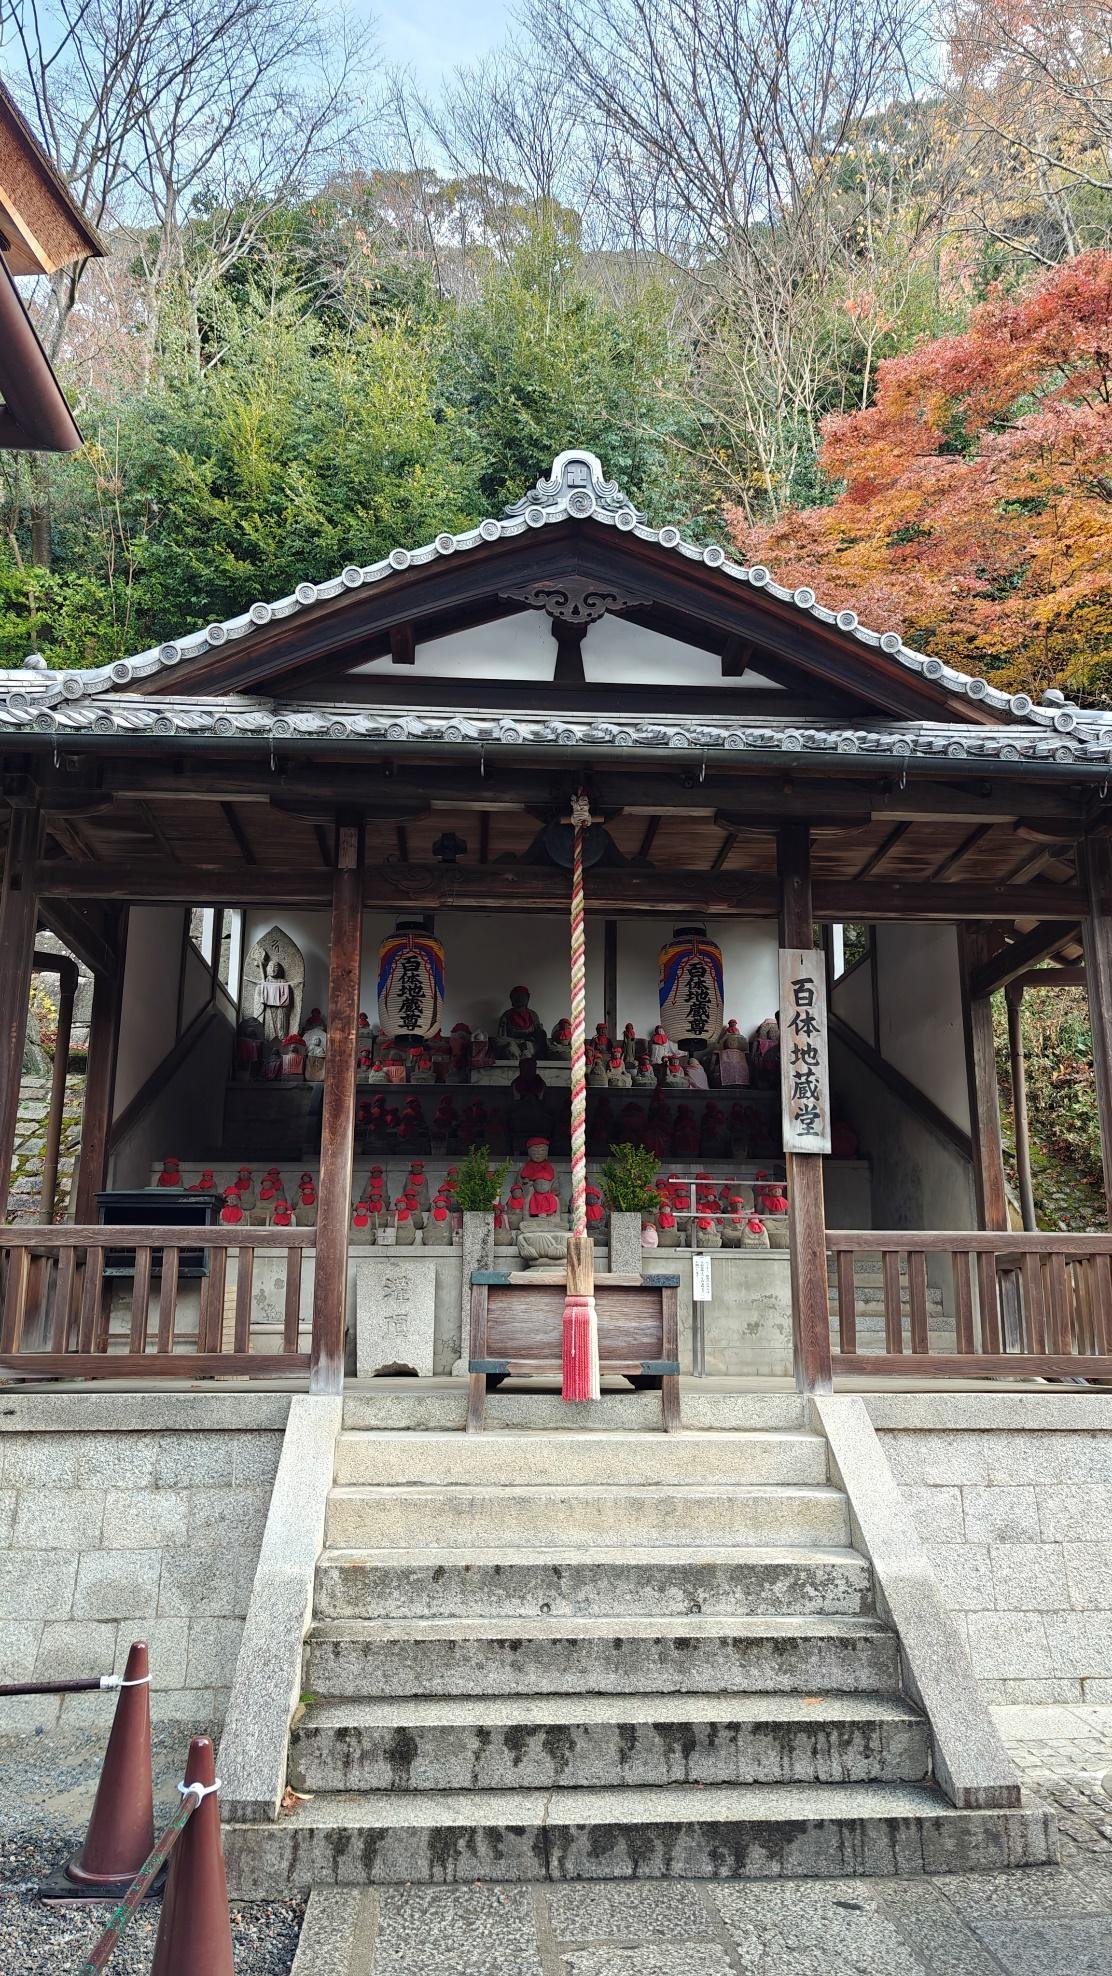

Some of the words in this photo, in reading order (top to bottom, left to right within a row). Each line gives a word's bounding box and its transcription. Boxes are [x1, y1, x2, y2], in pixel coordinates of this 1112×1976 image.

[787, 977, 821, 1137] 百体地蔵堂
